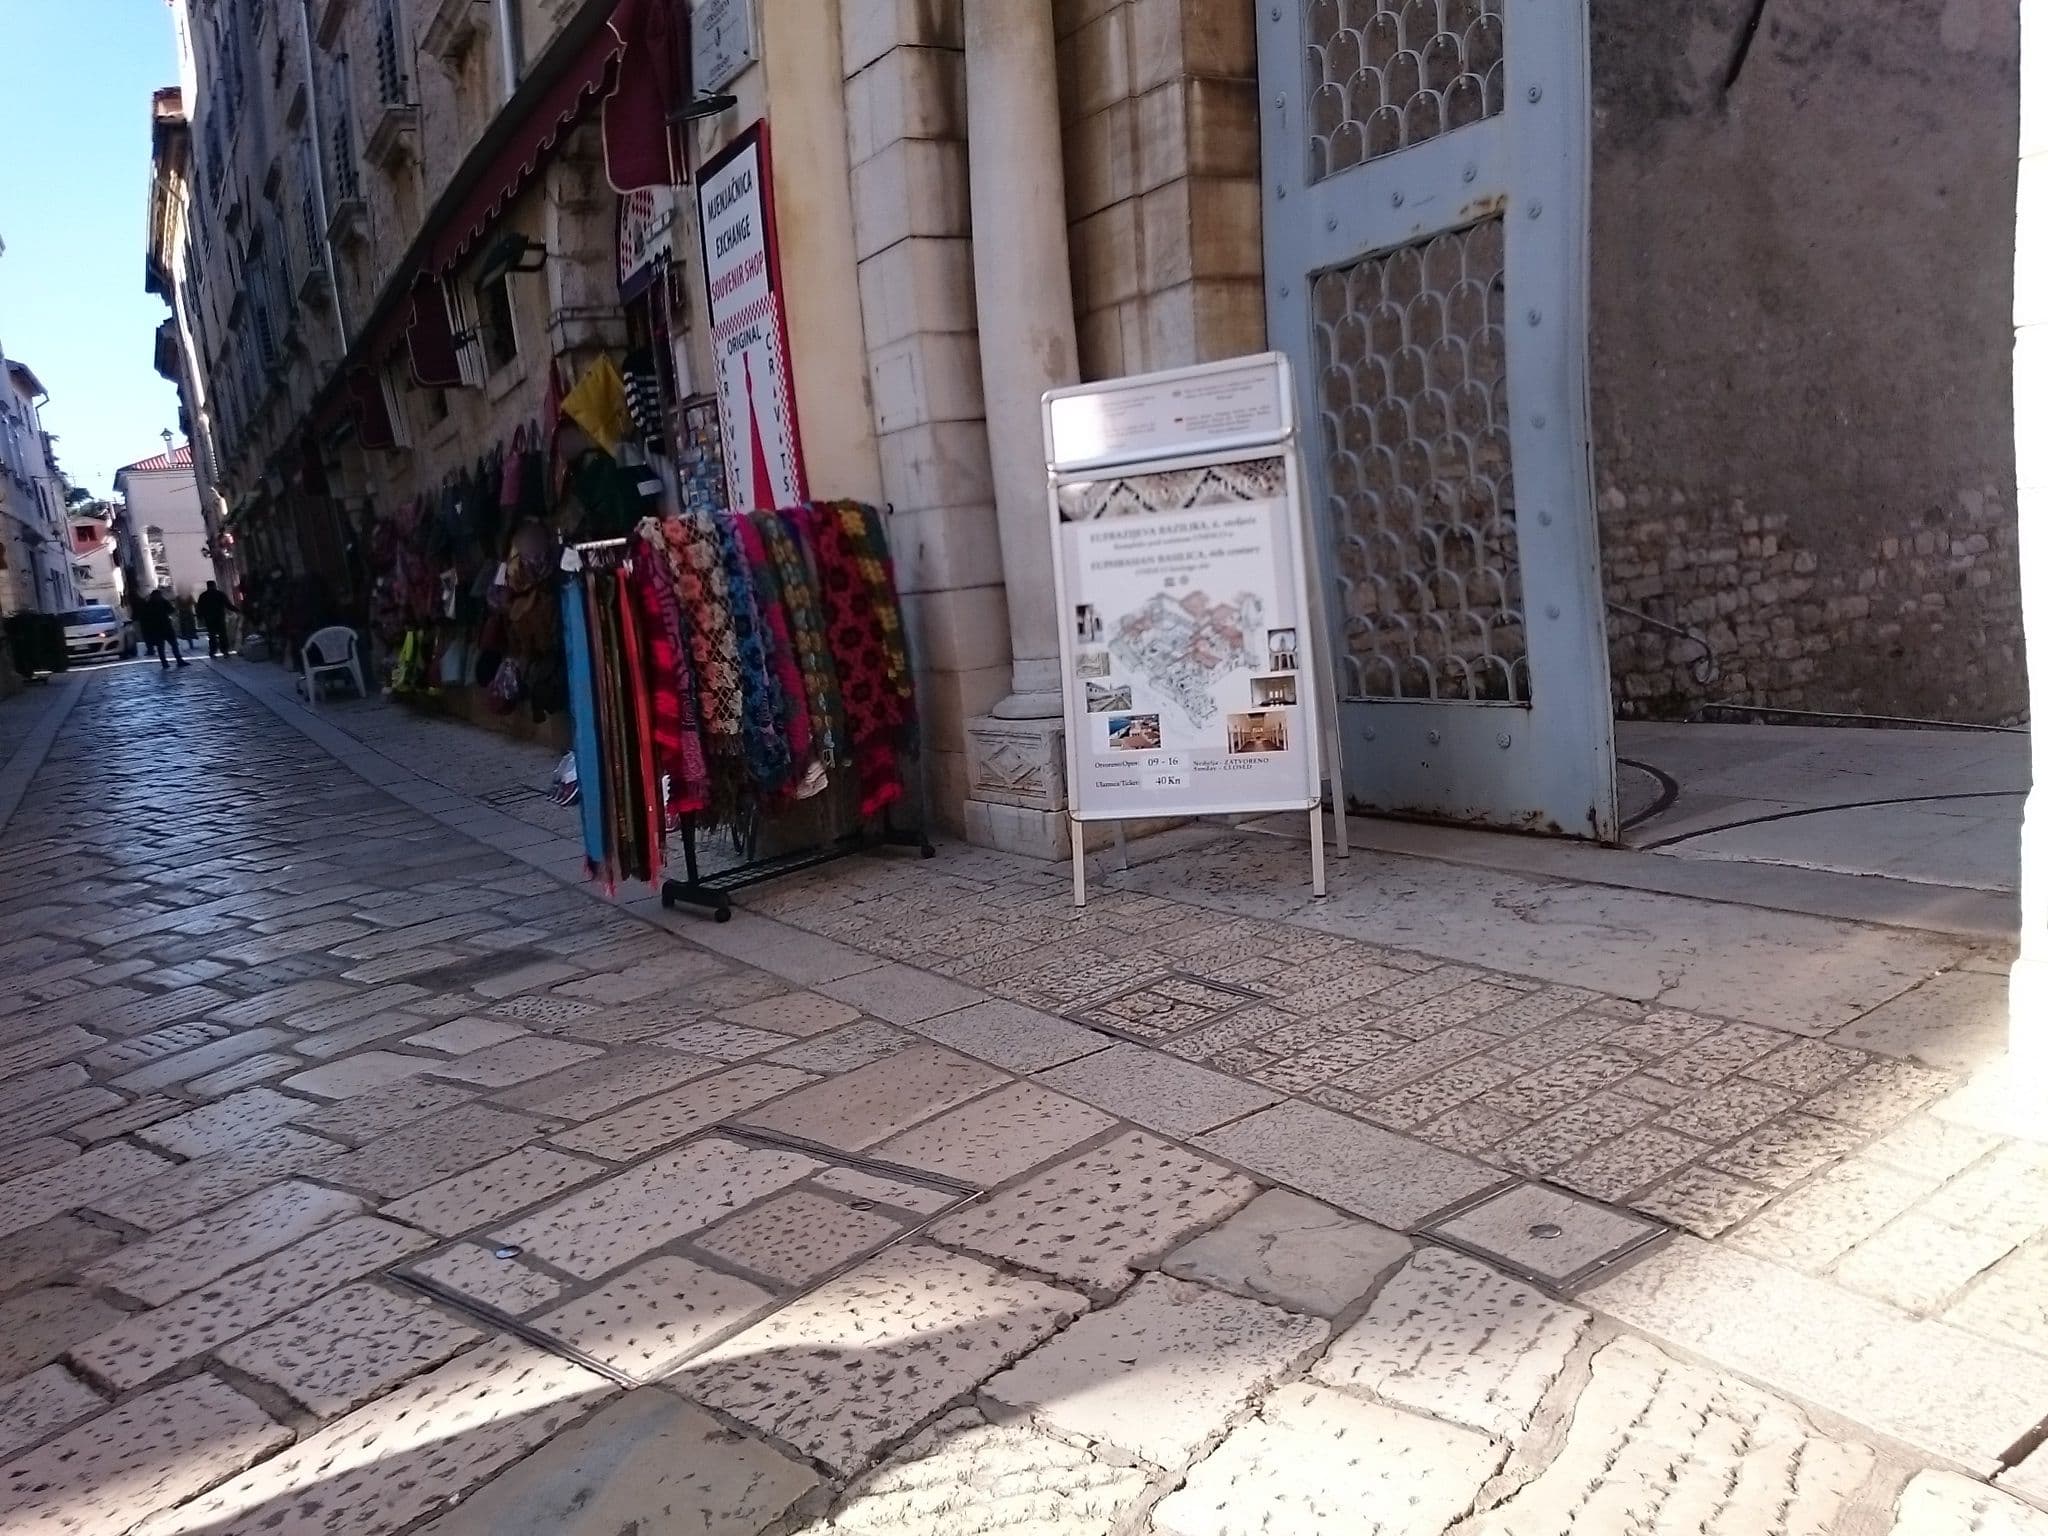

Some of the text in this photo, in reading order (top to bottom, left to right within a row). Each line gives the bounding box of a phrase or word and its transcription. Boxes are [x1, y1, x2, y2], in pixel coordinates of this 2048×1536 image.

[707, 169, 753, 224] MJENJAČNICA
[715, 213, 751, 259] EXCHANGE
[711, 249, 764, 304] SOUVENIR SHOP
[727, 324, 762, 355] ORIGINAL
[1147, 758, 1159, 767] 09
[1168, 757, 1179, 766] 16
[1223, 757, 1269, 766] ZATVORENO
[1155, 776, 1166, 785] 40
